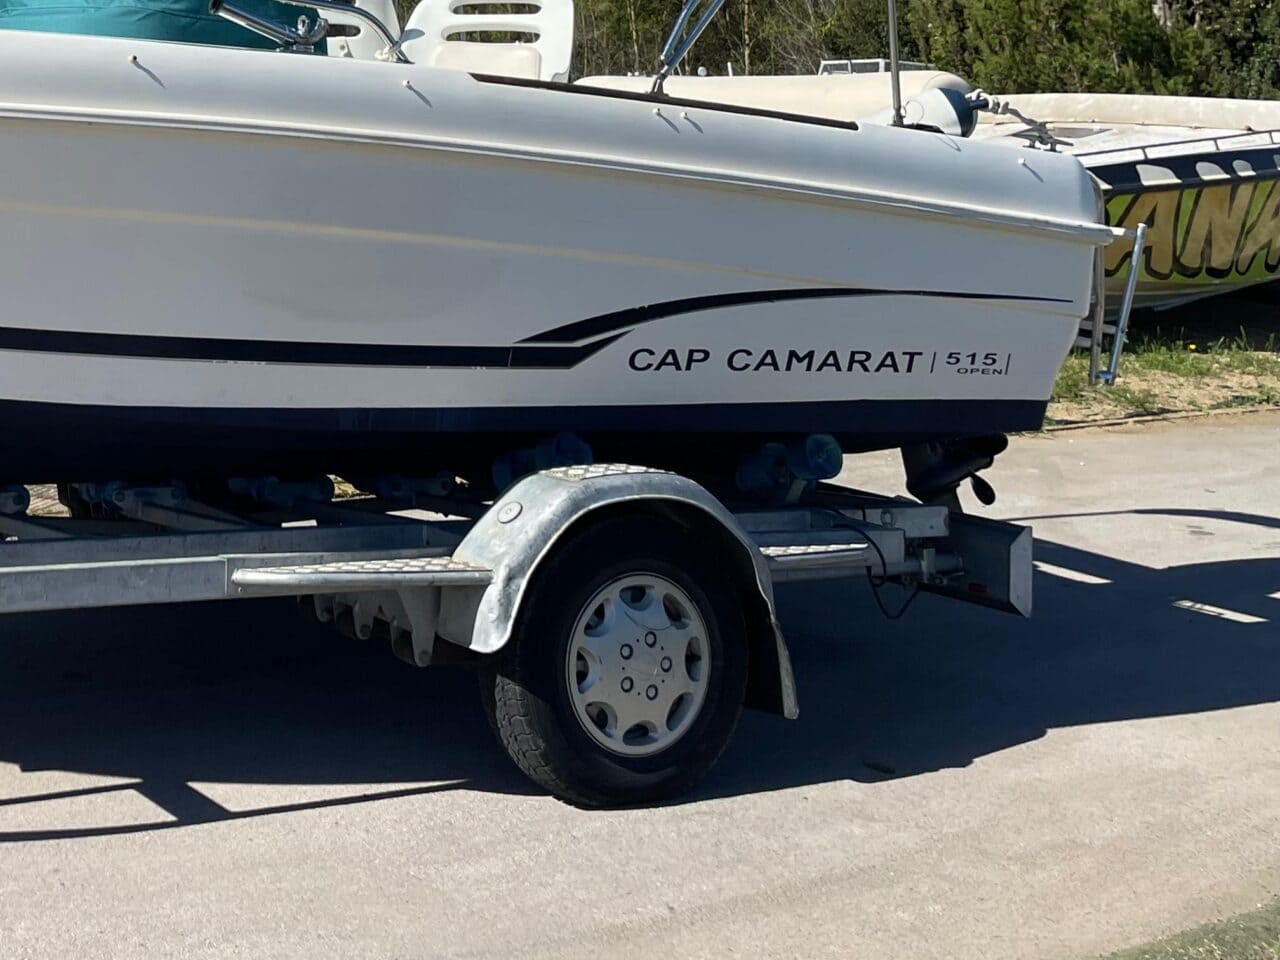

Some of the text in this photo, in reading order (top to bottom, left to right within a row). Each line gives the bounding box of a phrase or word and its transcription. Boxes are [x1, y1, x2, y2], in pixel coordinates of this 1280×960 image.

[628, 348, 998, 374] CAP CAMARAT 515
[957, 367, 1003, 375] OPEN
